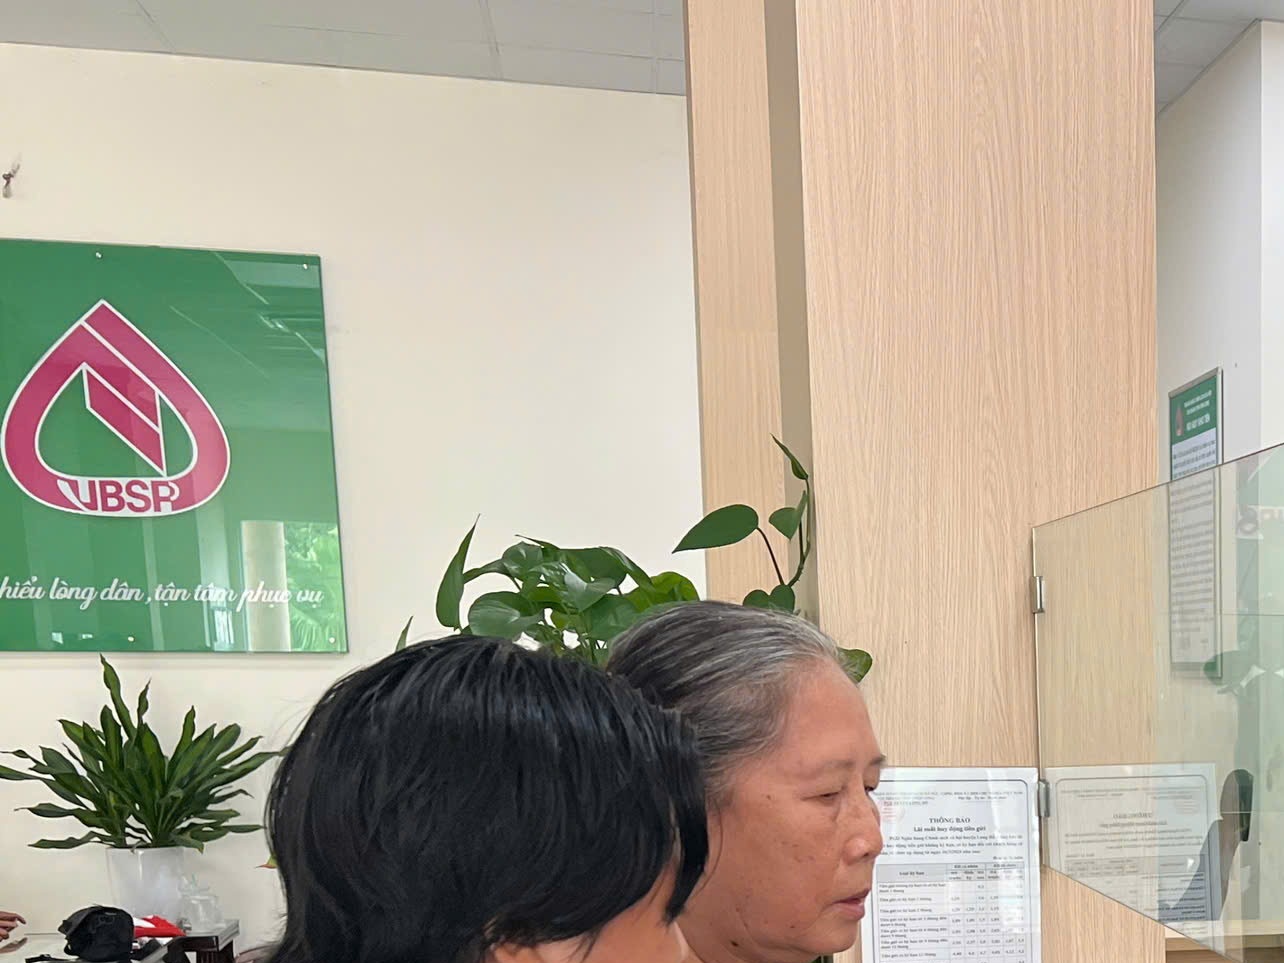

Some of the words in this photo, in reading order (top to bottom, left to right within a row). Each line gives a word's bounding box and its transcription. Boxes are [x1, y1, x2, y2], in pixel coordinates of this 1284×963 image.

[0, 575, 45, 600] hiểu
[49, 576, 98, 611] lòng
[154, 581, 191, 607] tận
[193, 582, 237, 602] tâm
[235, 580, 292, 613] phục
[296, 589, 324, 609] vụ
